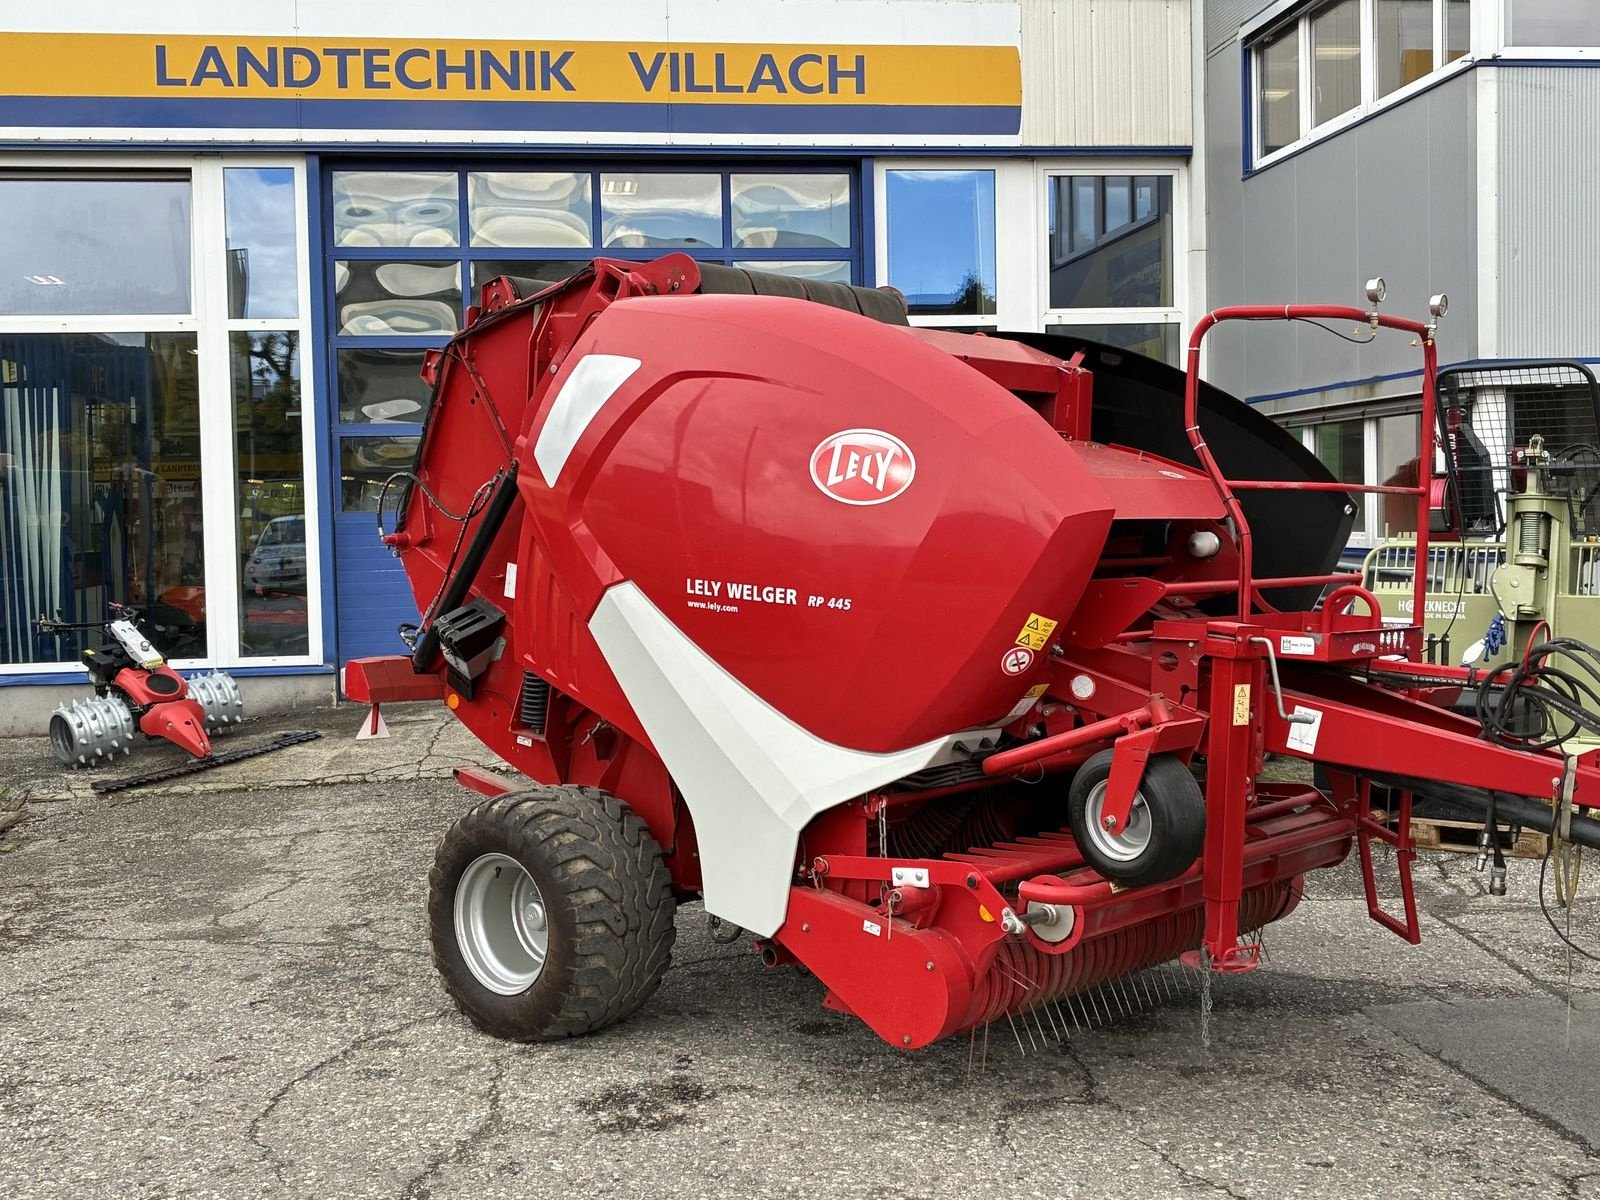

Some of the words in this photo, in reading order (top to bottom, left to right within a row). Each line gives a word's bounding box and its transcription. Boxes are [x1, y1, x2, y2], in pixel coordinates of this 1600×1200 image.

[157, 45, 576, 91] LANDTECHNIK
[629, 52, 865, 95] VILLACH
[826, 441, 898, 493] LELY
[686, 578, 722, 597] LELY
[726, 582, 798, 606] WELGER
[807, 595, 825, 608] RP
[827, 597, 852, 611] 445
[687, 600, 739, 613] www.lely.com
[1398, 600, 1466, 614] HOZKNECHT
